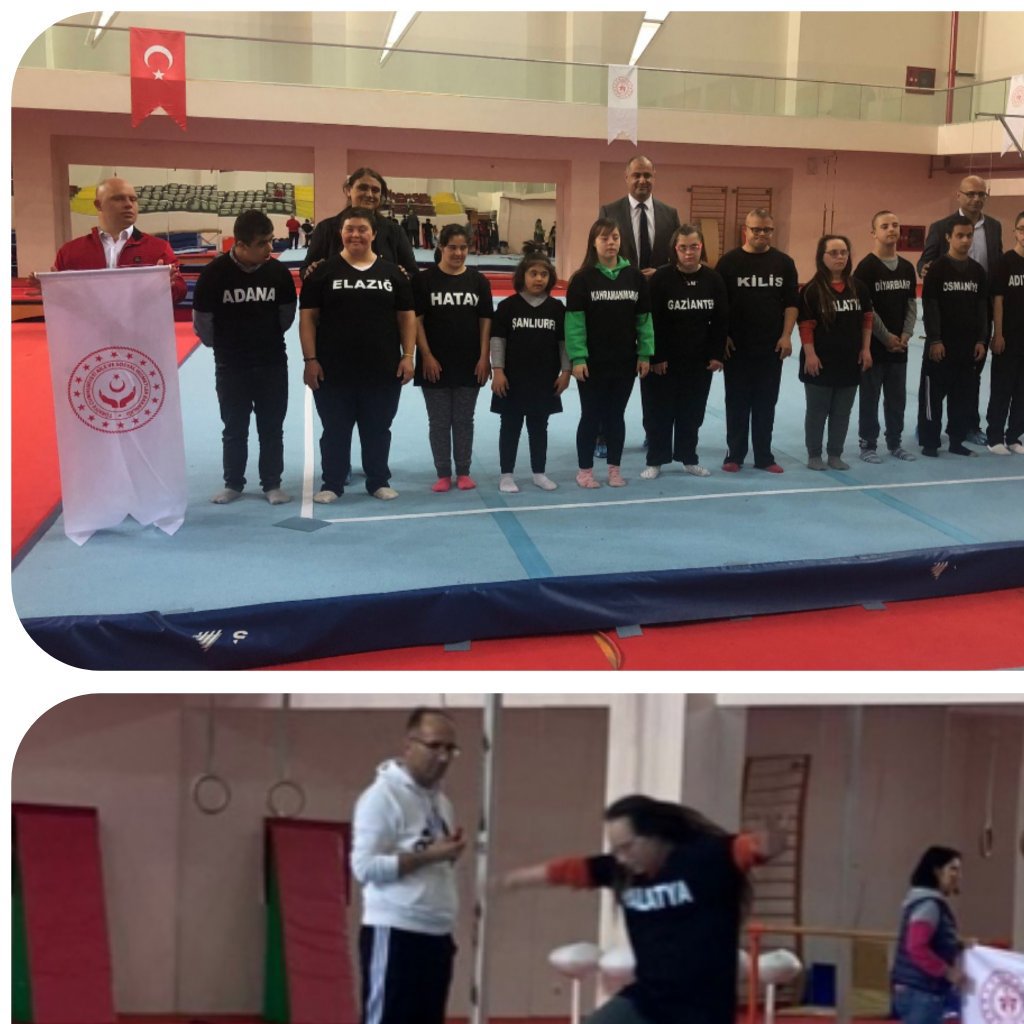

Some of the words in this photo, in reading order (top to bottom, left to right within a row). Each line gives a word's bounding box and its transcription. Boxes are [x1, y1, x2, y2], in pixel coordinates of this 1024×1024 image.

[332, 279, 393, 292] ELAZIĞ
[737, 274, 783, 288] KİLİS
[222, 286, 276, 303] ADANA
[431, 292, 479, 306] HATAY
